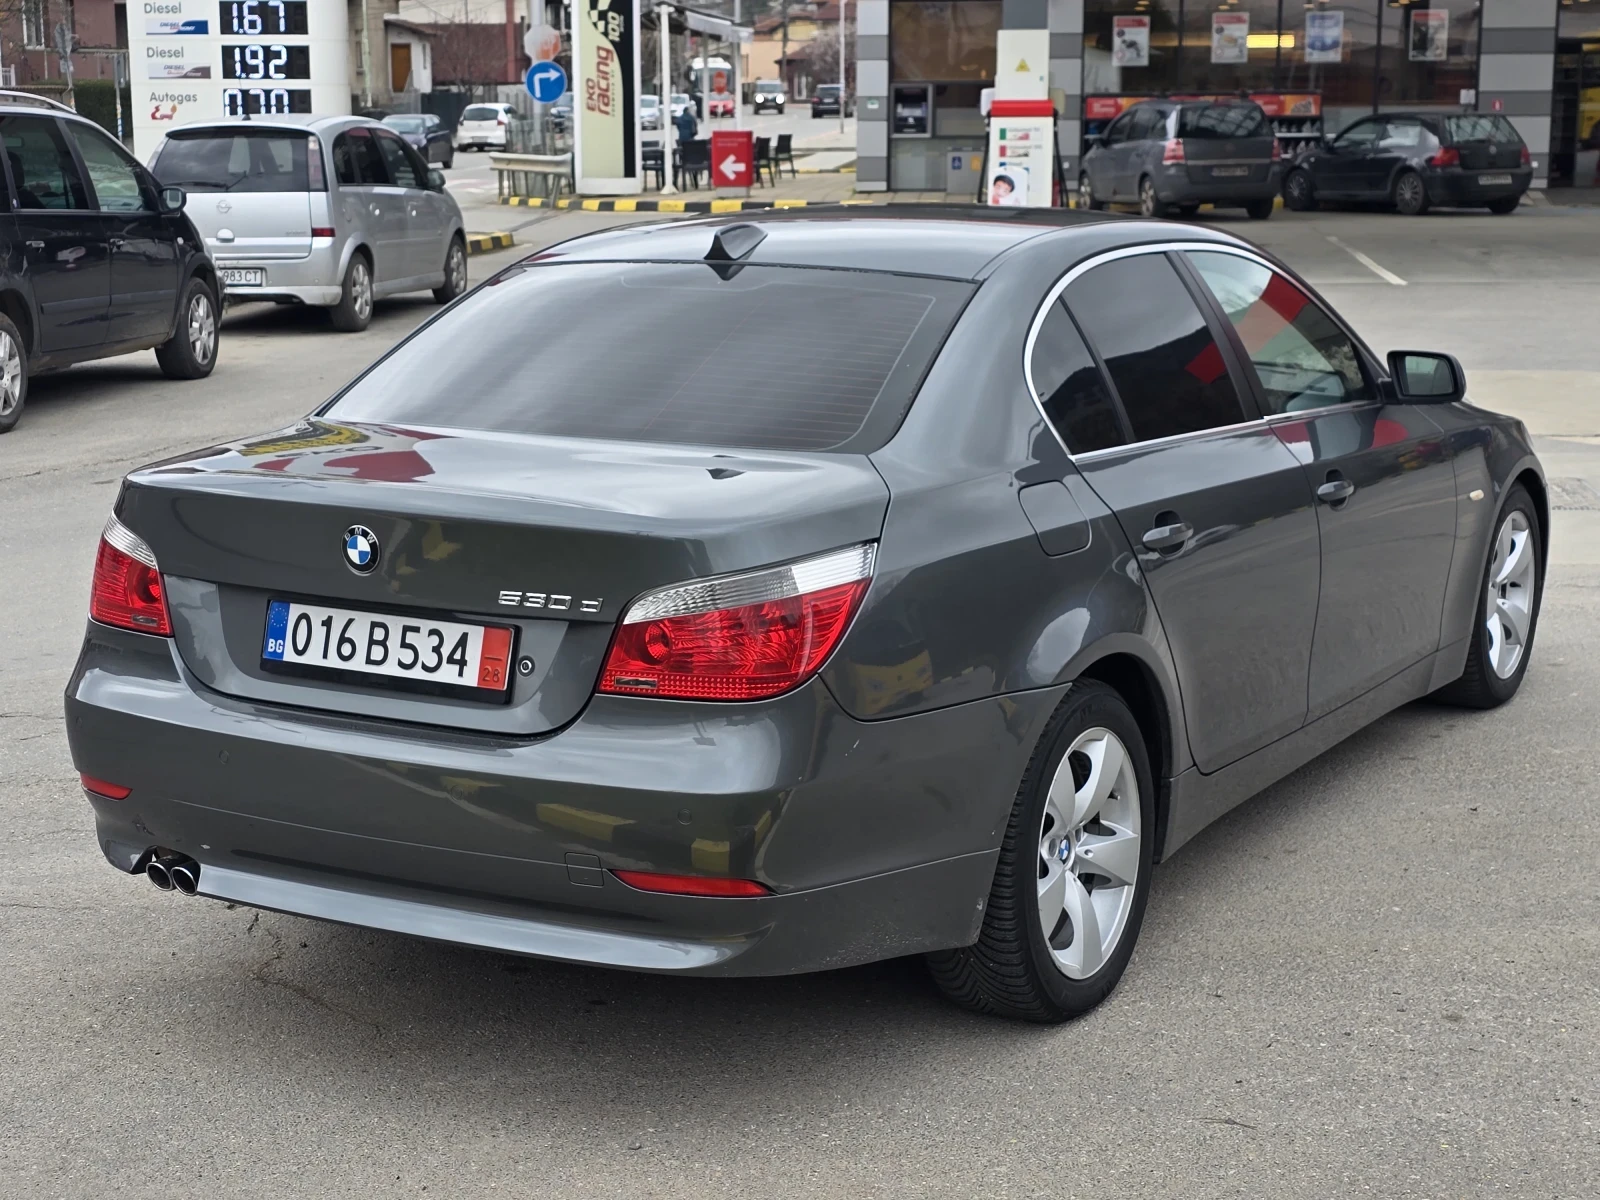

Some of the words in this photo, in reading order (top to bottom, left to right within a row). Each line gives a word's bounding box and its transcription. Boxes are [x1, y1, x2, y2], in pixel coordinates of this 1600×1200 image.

[144, 1, 182, 14] Diesel
[232, 0, 286, 35] 1.67
[607, 11, 620, 41] 100
[146, 46, 184, 58] Diesel
[234, 44, 288, 79] 1.92
[596, 45, 614, 116] racing
[149, 91, 198, 105] Autogas
[586, 77, 596, 112] EKO
[267, 638, 284, 653] BG
[482, 665, 501, 683] 28
